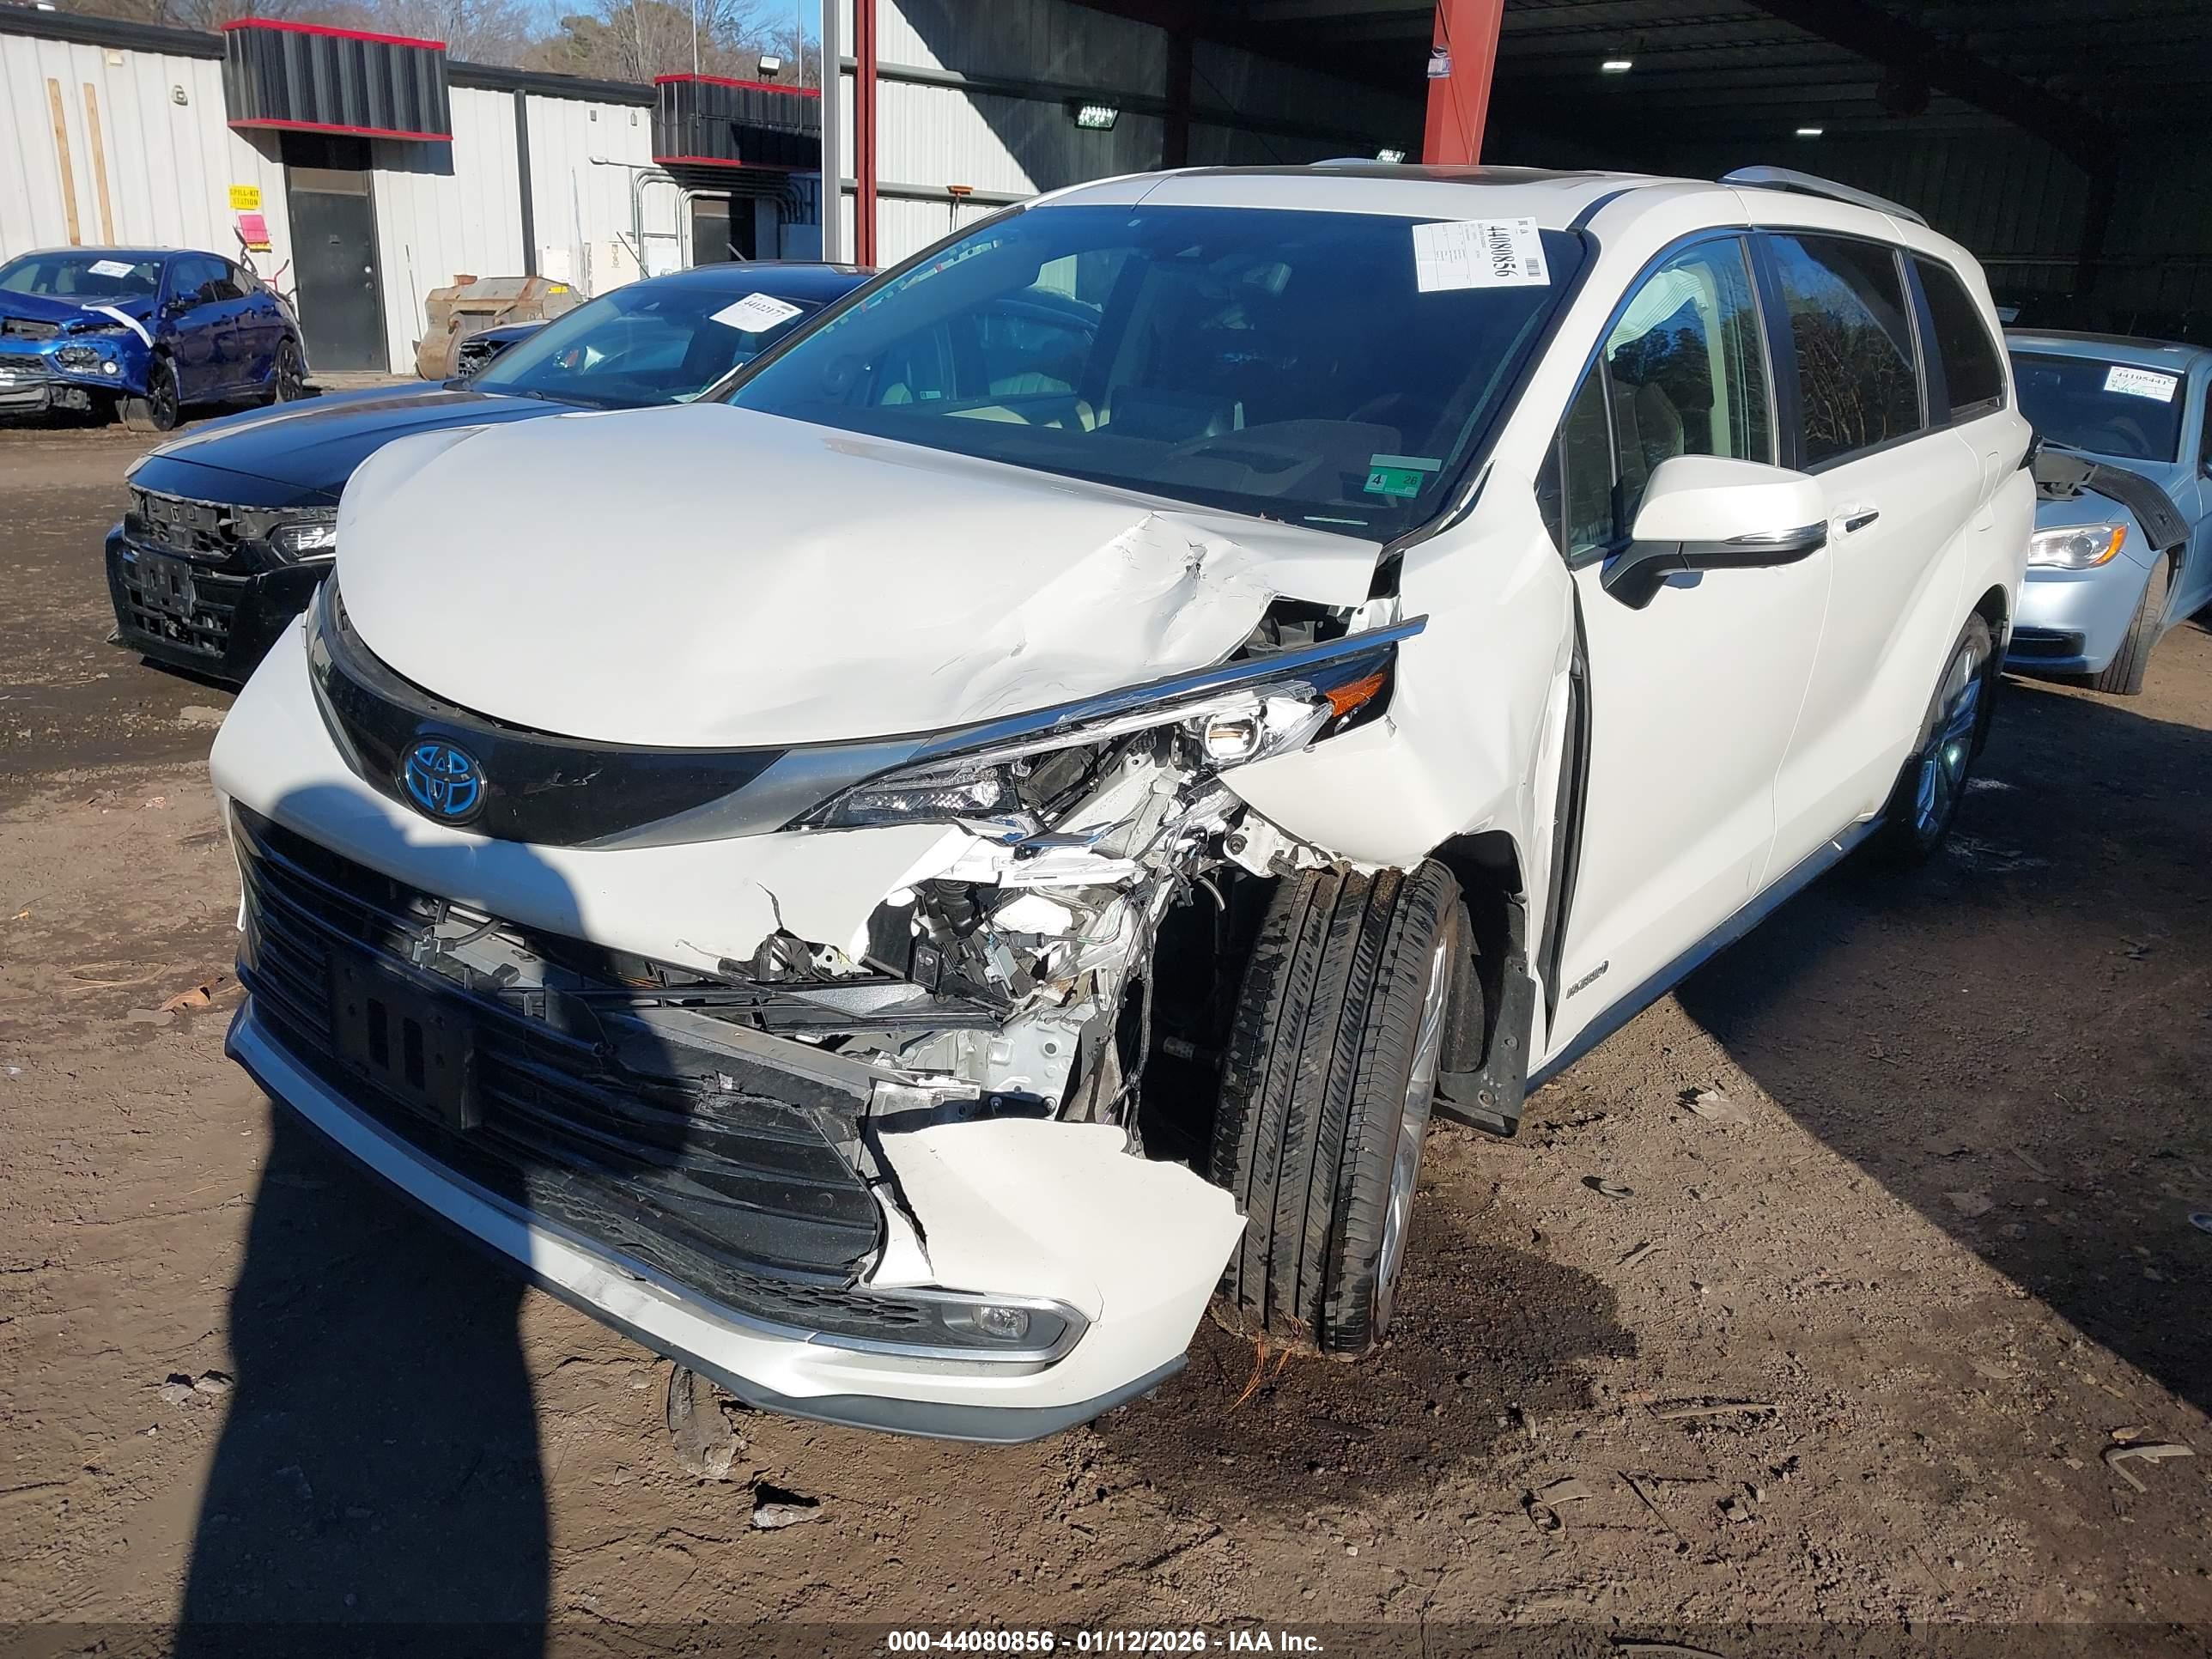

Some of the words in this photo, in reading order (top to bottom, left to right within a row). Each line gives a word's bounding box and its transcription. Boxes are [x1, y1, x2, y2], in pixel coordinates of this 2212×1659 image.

[230, 187, 259, 197] SPILL-KIT
[233, 198, 258, 206] STATION
[1486, 225, 1519, 277] 44080856
[1372, 474, 1382, 485] 4
[1403, 475, 1419, 485] 26
[1565, 960, 1609, 1000] HYBRID
